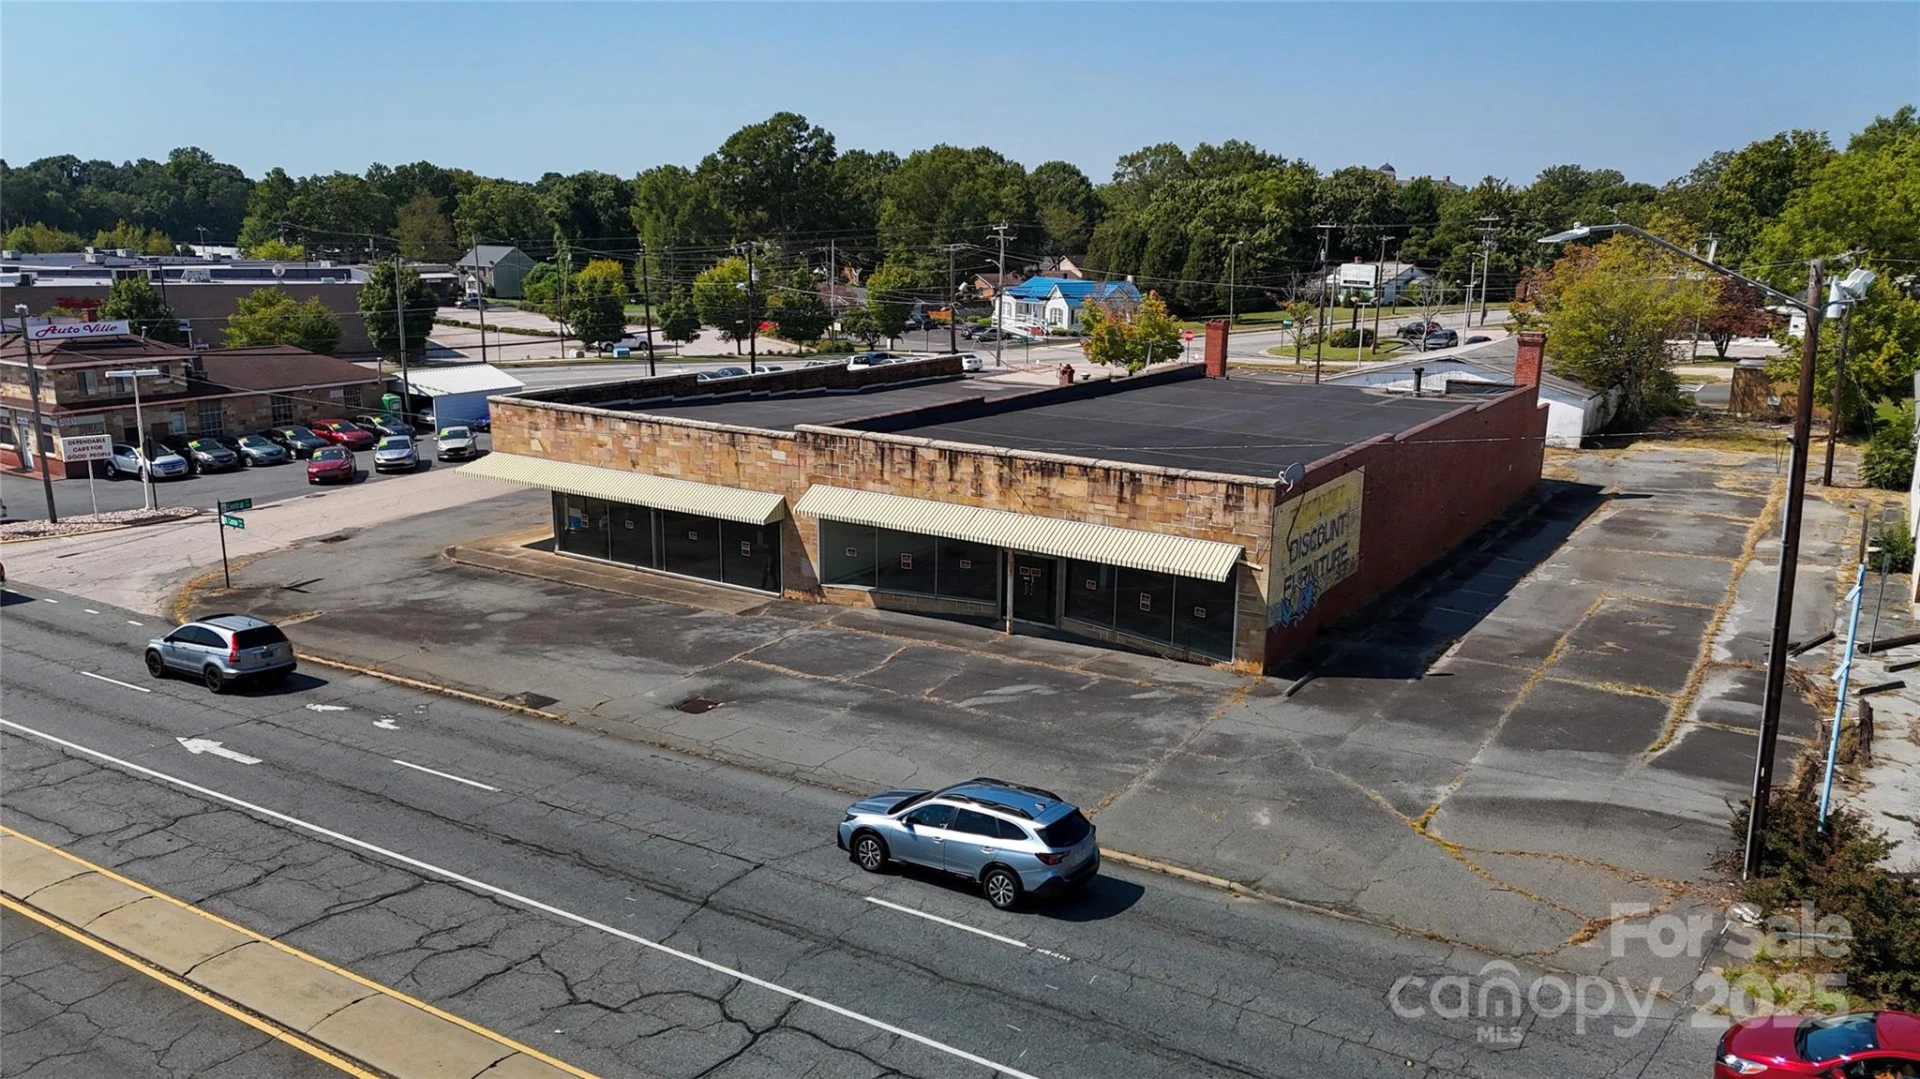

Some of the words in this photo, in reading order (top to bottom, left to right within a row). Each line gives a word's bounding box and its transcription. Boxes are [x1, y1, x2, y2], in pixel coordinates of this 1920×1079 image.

[35, 325, 80, 337] Auto
[83, 324, 117, 333] Ville
[1289, 511, 1348, 565] DISCOUNT
[1284, 542, 1349, 599] FURNITURE
